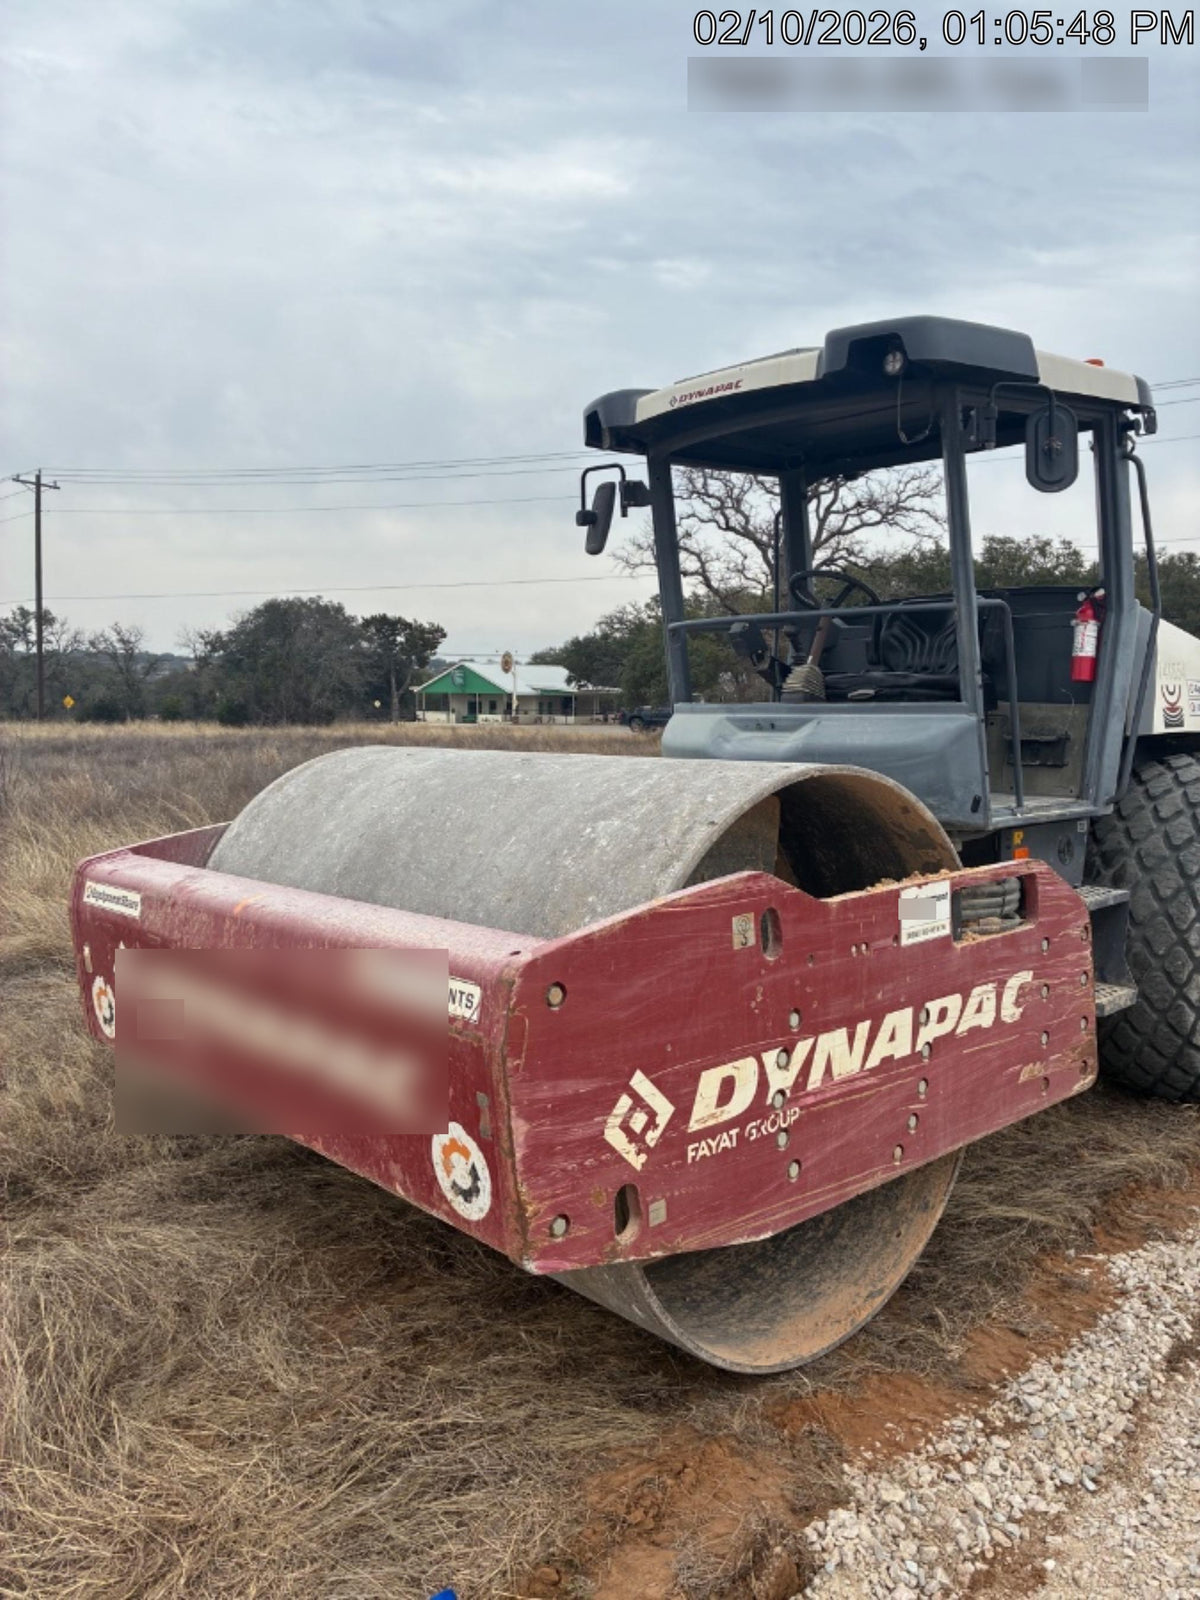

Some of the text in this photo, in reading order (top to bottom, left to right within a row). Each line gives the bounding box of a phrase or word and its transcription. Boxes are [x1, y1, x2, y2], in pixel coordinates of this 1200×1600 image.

[679, 379, 743, 402] DYNAPAC
[687, 970, 1033, 1132] DYNAPAC
[687, 1106, 800, 1165] FAYAT GROUP
